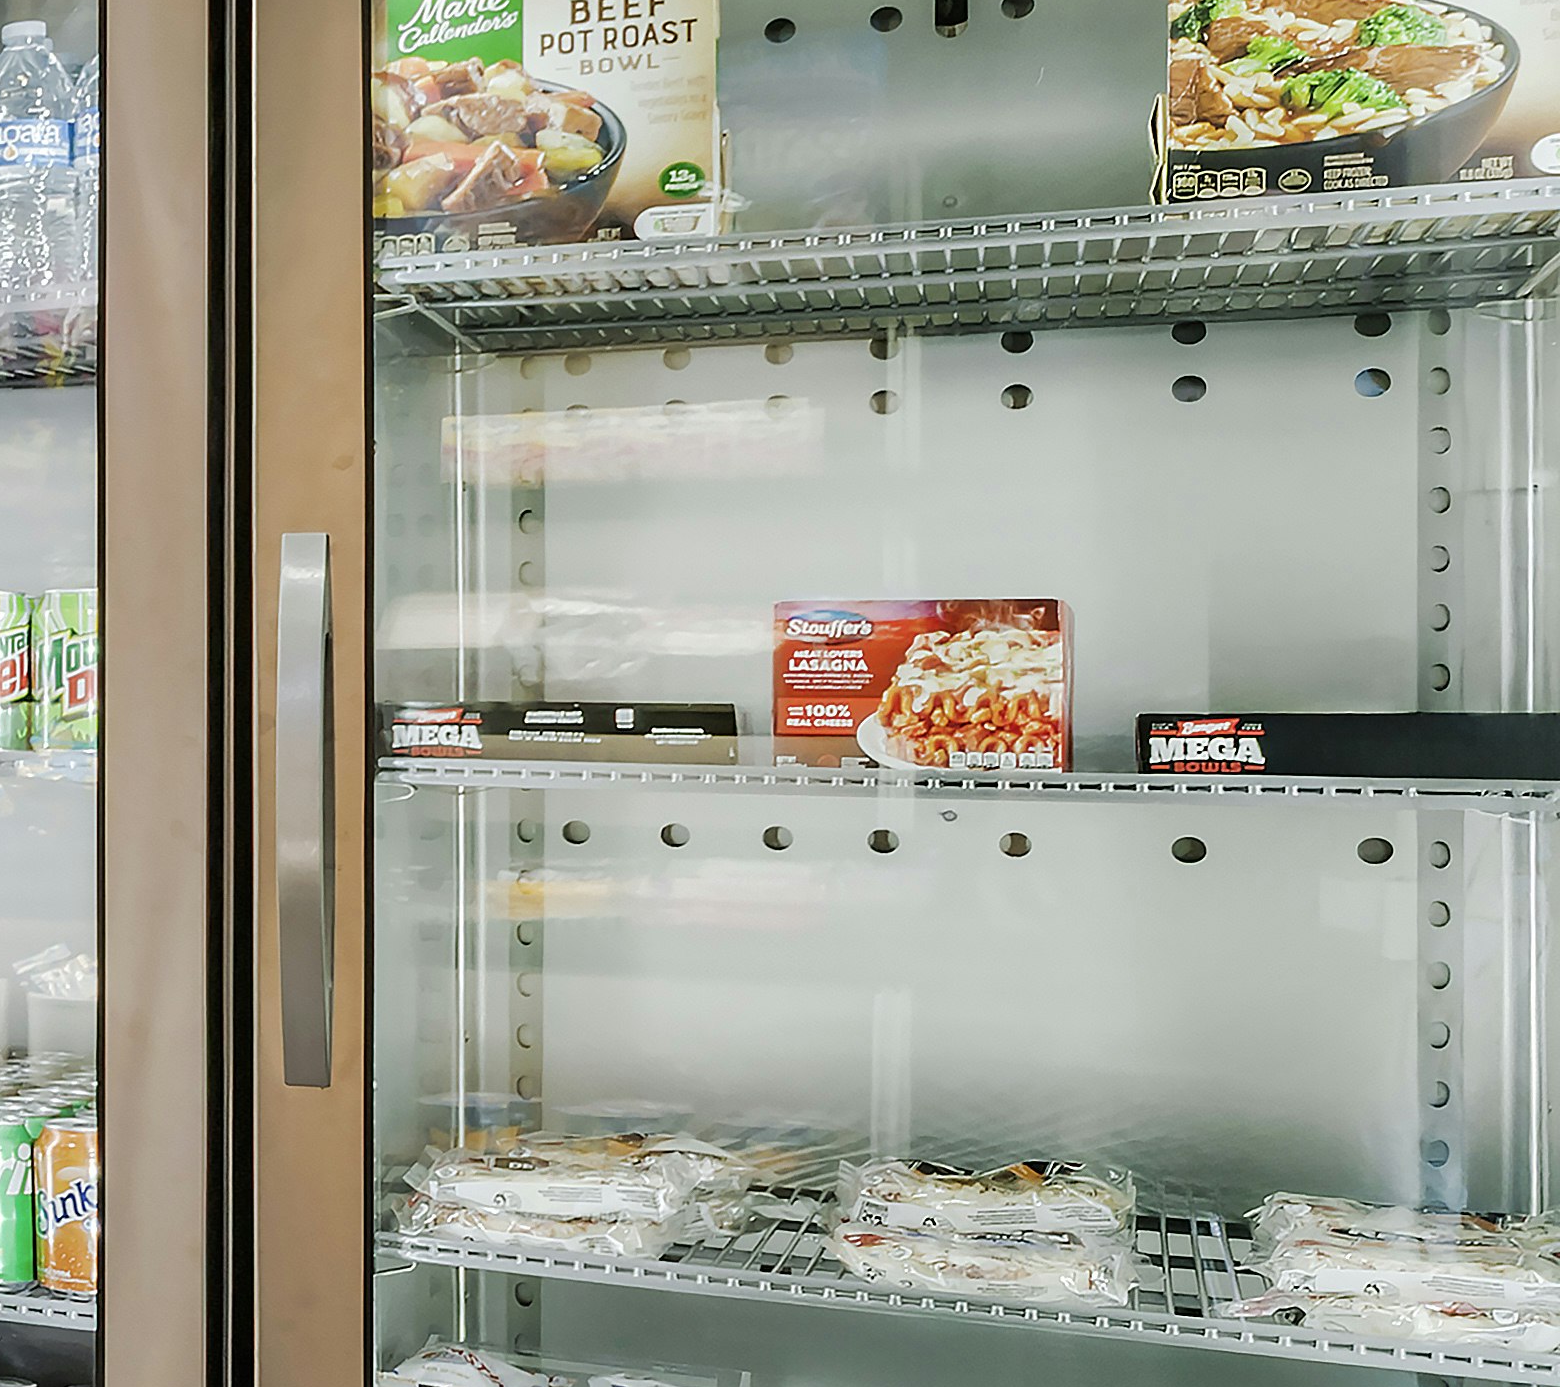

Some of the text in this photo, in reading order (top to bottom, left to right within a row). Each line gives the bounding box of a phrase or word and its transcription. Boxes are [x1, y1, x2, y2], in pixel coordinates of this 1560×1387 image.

[398, 11, 520, 55] Callender's
[539, 18, 698, 57] POT ROAST
[580, 55, 661, 75] BOWL
[786, 619, 872, 638] Stouffer's
[789, 659, 868, 671] LASAGNA
[805, 704, 850, 717] 100%
[392, 724, 482, 749] MEGA
[1149, 737, 1265, 765] MEGA
[1173, 762, 1242, 773] BOWLS
